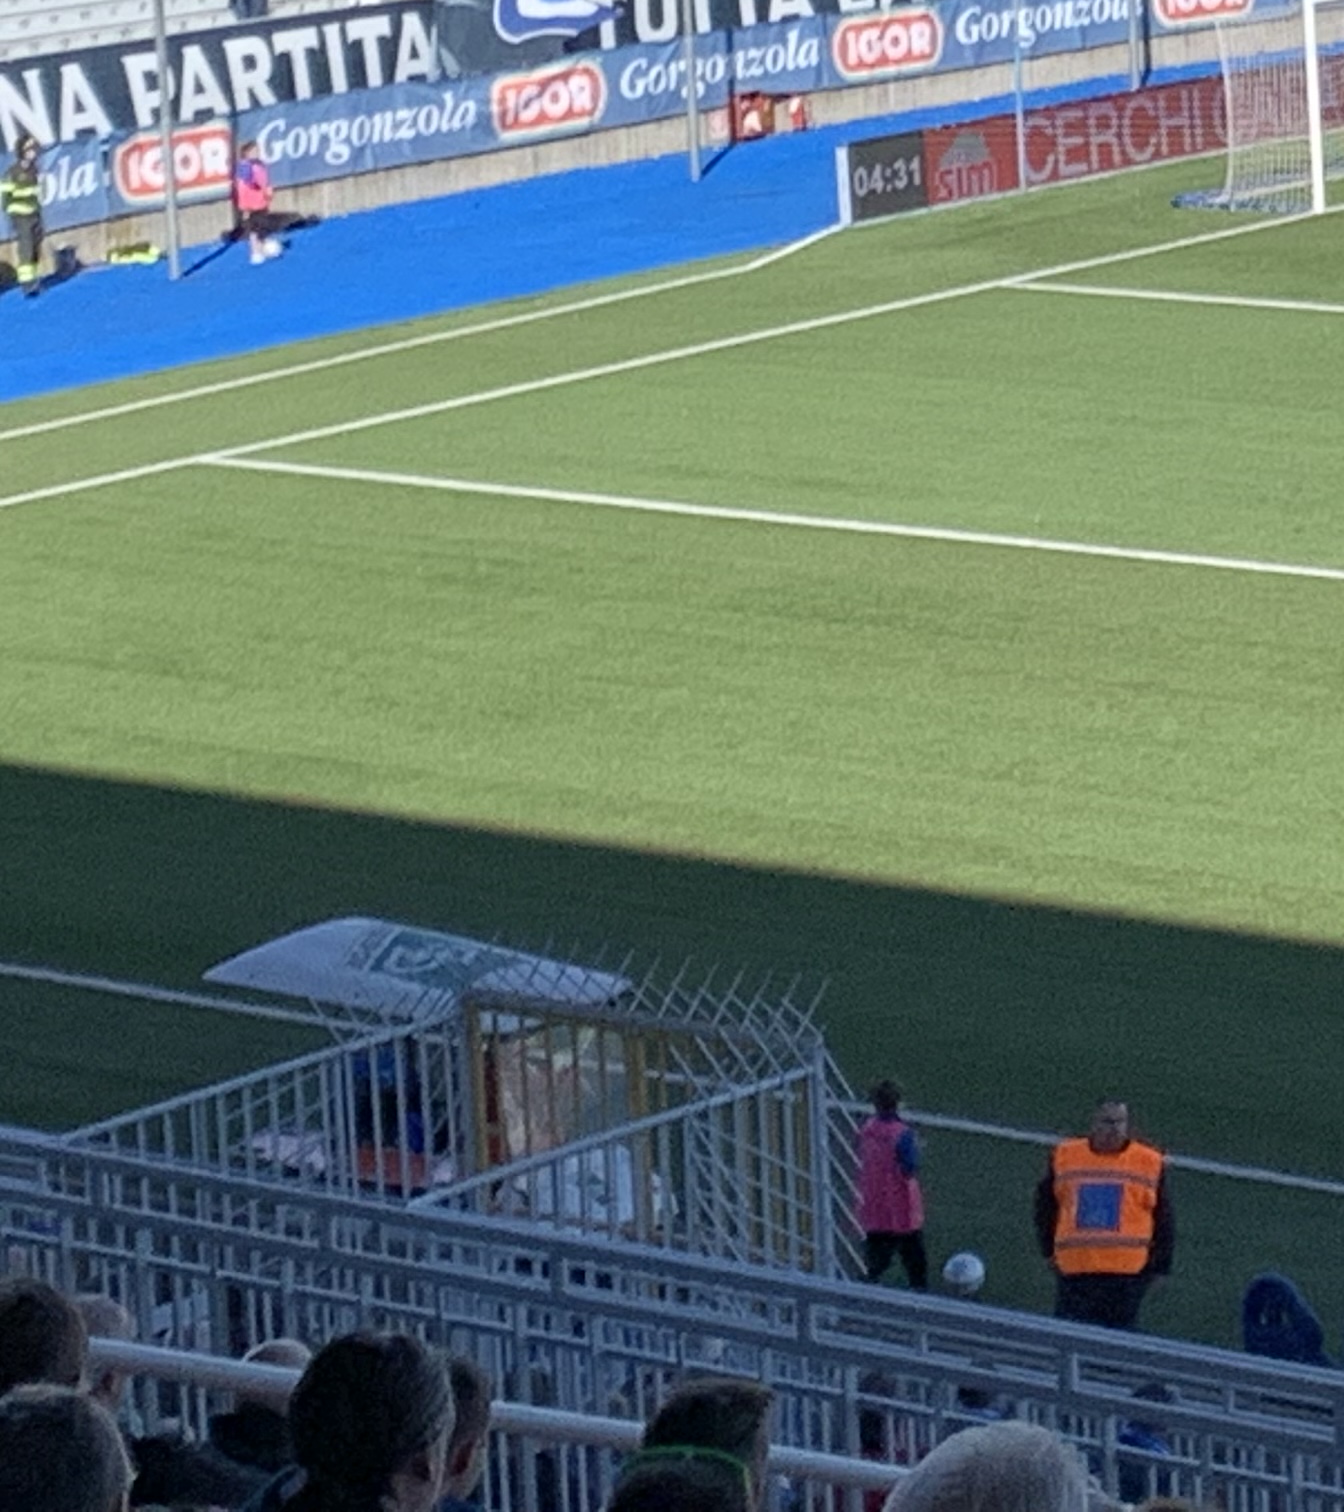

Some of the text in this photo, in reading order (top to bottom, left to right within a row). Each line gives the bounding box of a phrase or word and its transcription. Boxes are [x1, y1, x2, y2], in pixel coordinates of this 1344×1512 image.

[121, 11, 442, 130] PARTITA
[845, 22, 933, 68] IGOR
[502, 73, 594, 127] IGOR
[255, 90, 478, 166] Gorgonzola
[1022, 88, 1206, 183] CERCHI
[127, 136, 231, 189] IGOR
[853, 154, 922, 198] 04:31
